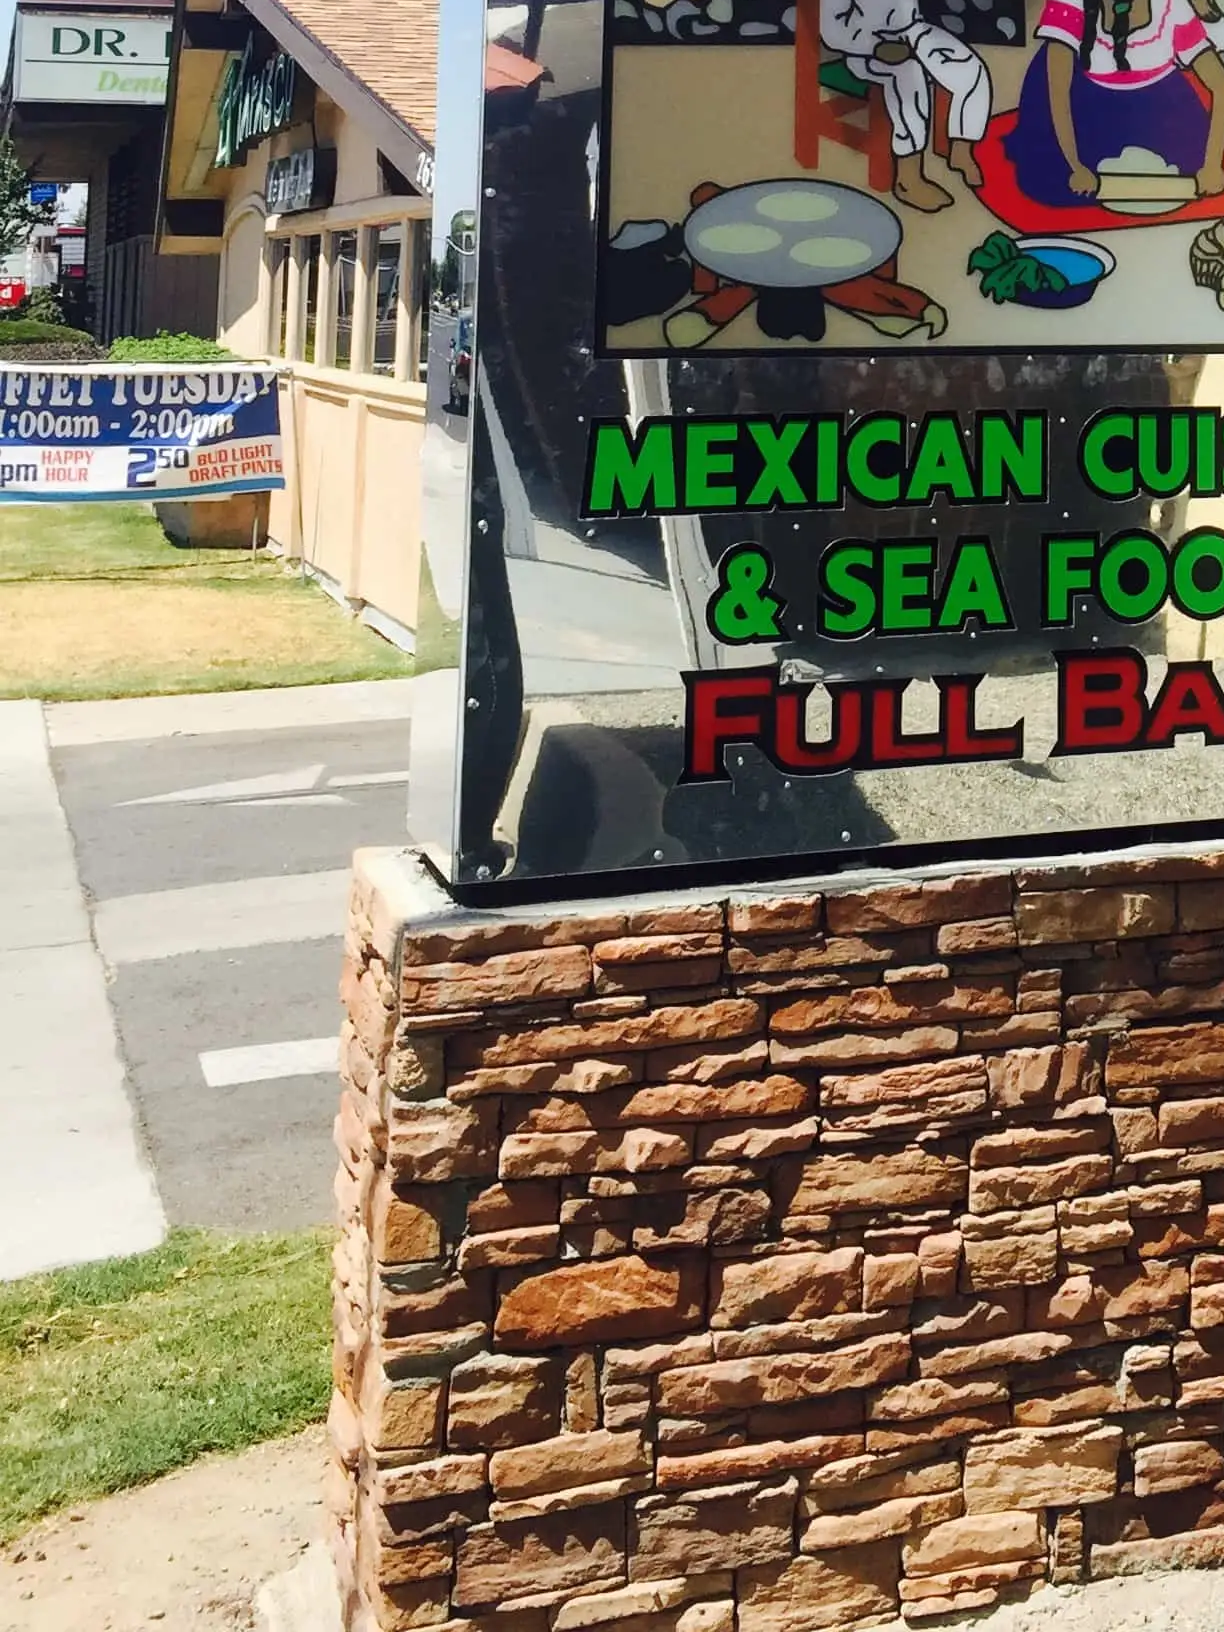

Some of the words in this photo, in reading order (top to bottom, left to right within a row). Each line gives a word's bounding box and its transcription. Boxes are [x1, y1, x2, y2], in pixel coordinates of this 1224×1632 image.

[52, 27, 138, 57] DR.
[0, 370, 97, 406] FFET
[108, 370, 276, 405] TUESDAY
[128, 409, 234, 446] 2:00pm
[41, 450, 94, 464] HAPPY
[189, 465, 238, 483] DRAFT
[240, 458, 282, 475] PINTS
[197, 452, 228, 466] BUD
[232, 444, 272, 460] LIGHT
[581, 410, 1049, 517] MEXICAN
[45, 468, 88, 482] HOUR
[707, 542, 788, 644] &
[817, 533, 1010, 639] SEA
[677, 668, 1023, 785] FULL
